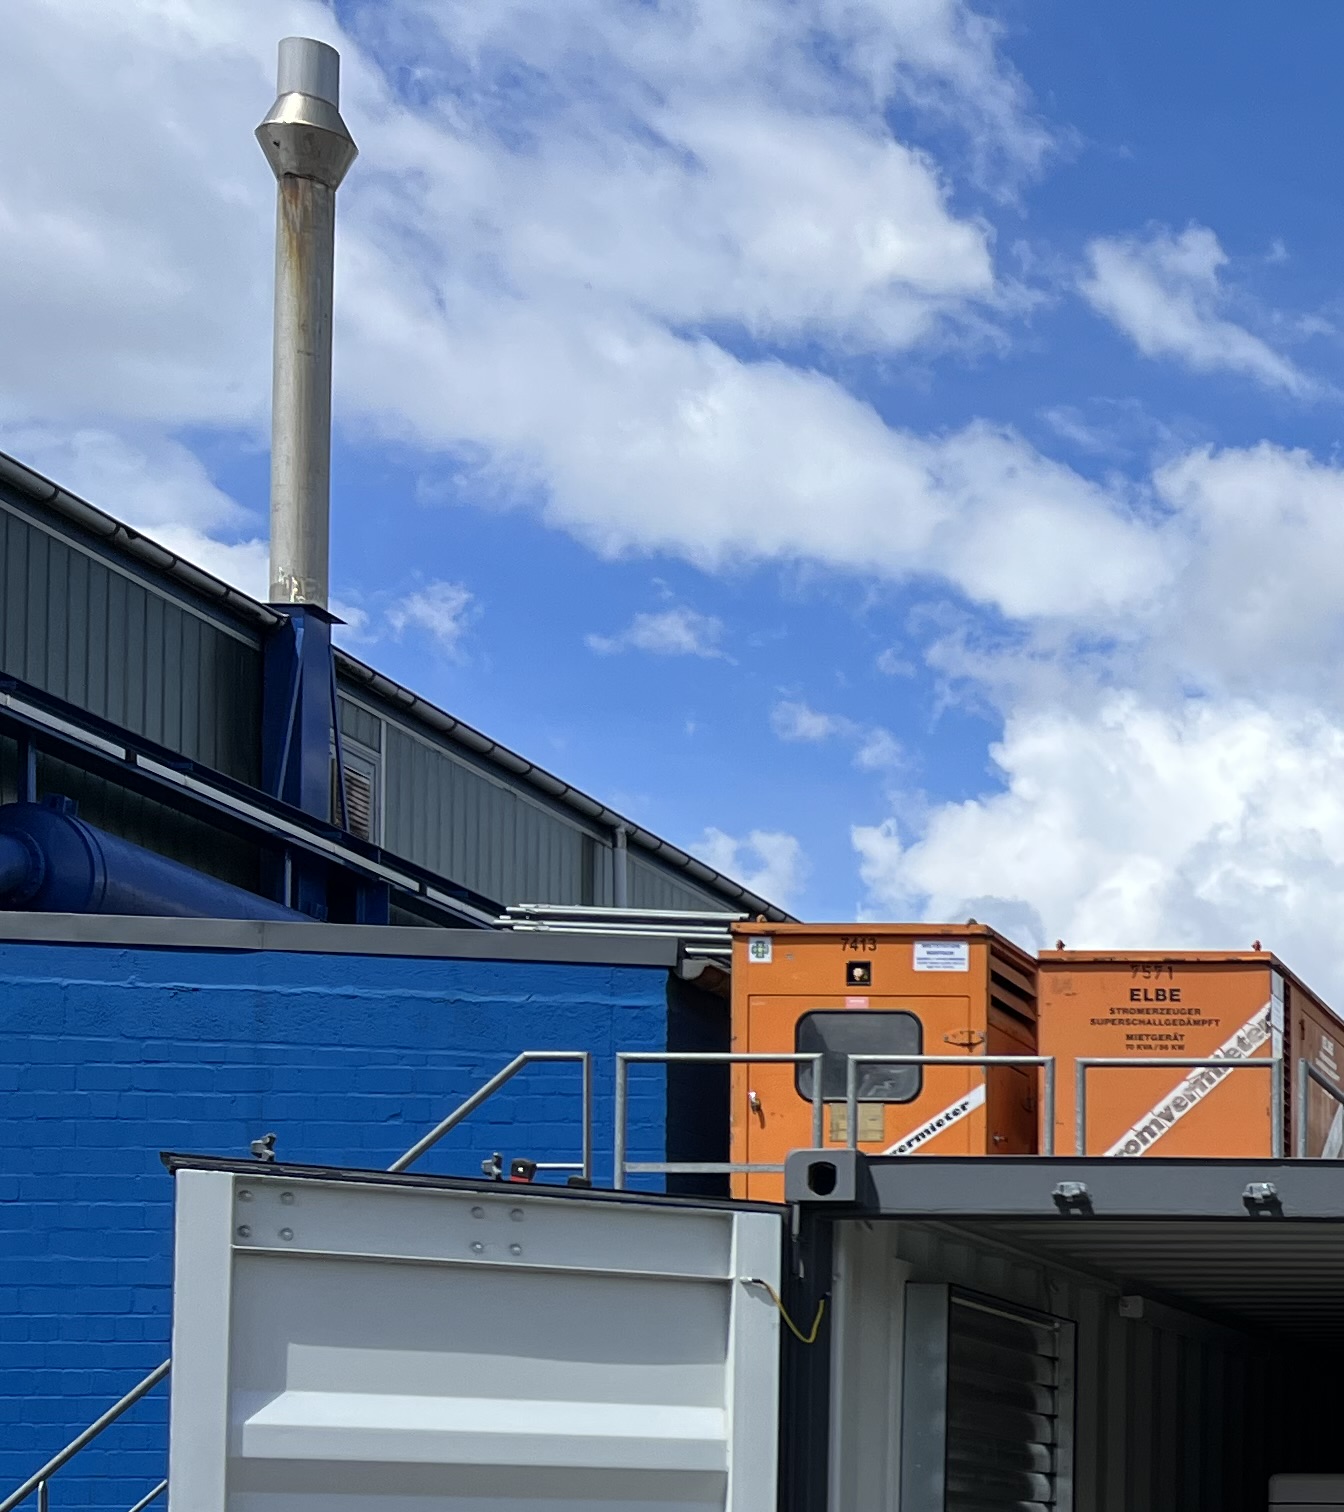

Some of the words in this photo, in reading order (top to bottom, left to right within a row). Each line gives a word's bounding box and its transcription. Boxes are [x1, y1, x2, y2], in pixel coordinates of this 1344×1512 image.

[840, 937, 878, 952] 7413
[1129, 964, 1174, 980] 7571
[1129, 988, 1182, 1003] ELBE
[1109, 1007, 1202, 1016] STROMERZEUGER
[1090, 1017, 1221, 1027] SUPERSCHALLGEDÄMPFT
[1125, 1032, 1185, 1042] MIETGERÄT
